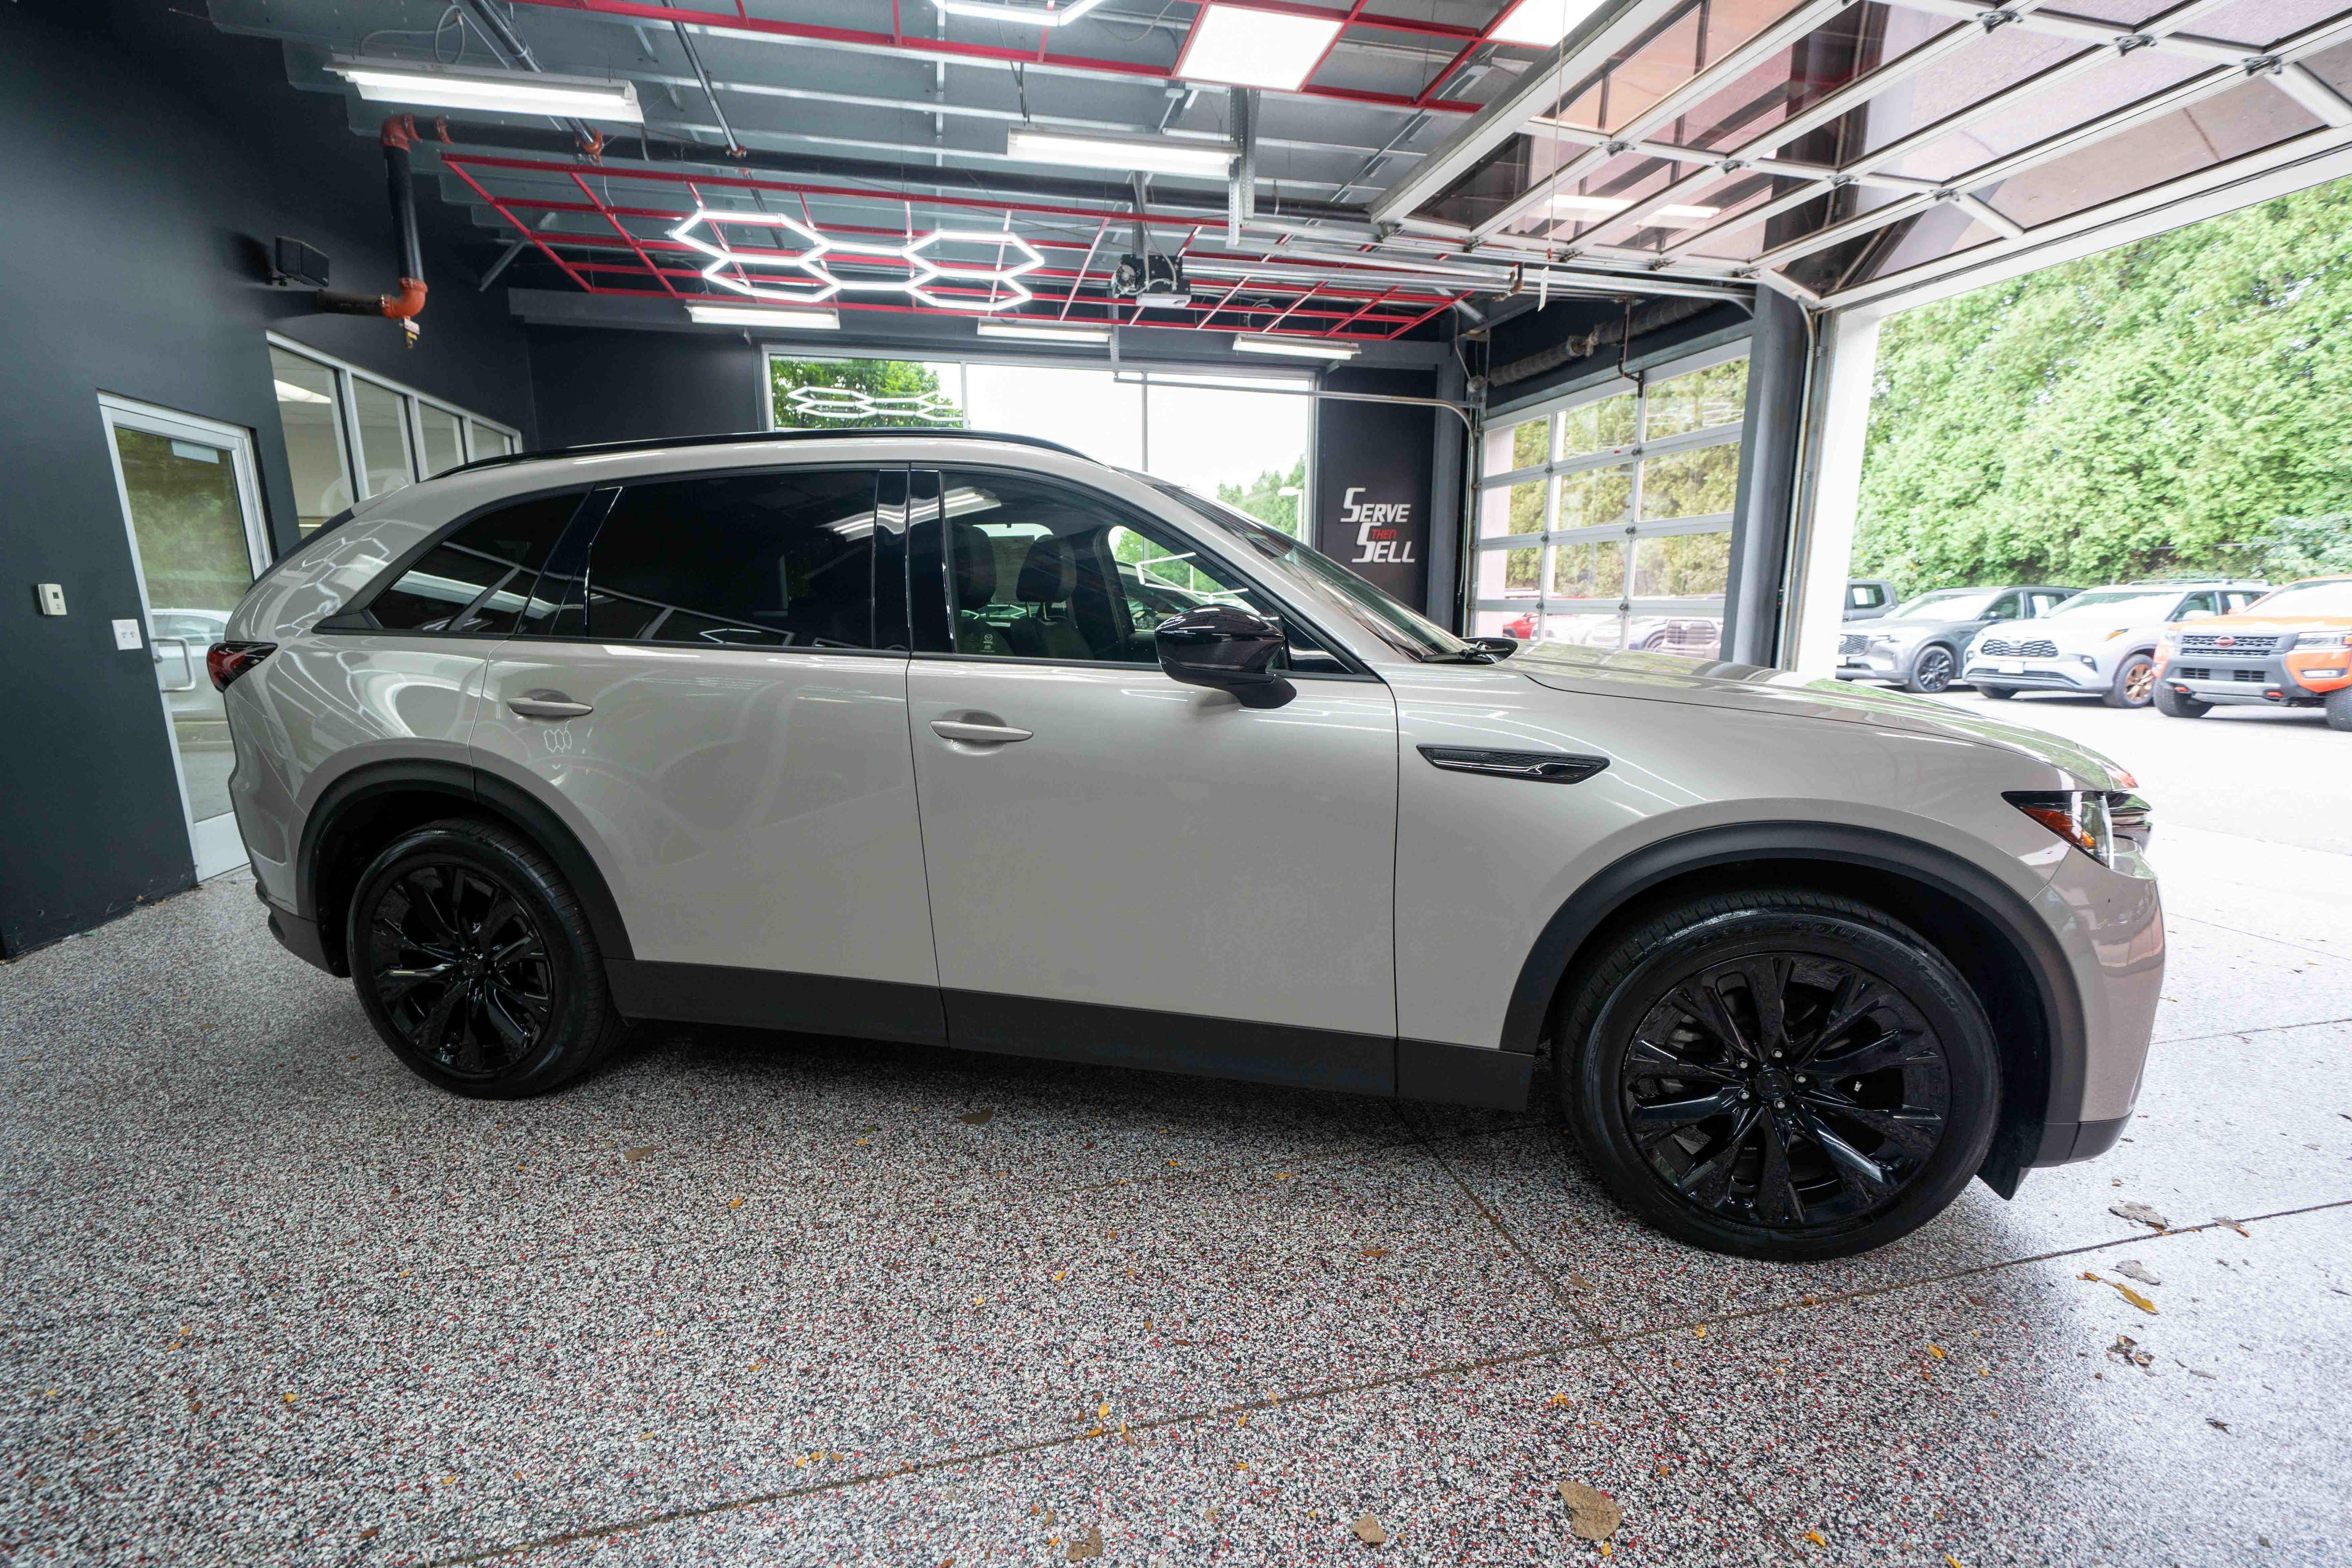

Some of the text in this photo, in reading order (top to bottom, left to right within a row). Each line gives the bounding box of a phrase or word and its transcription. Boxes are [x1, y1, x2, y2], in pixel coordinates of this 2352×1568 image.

[1340, 488, 1411, 522] SERVE
[1352, 522, 1415, 563] SELL
[1372, 529, 1396, 540] THEN
